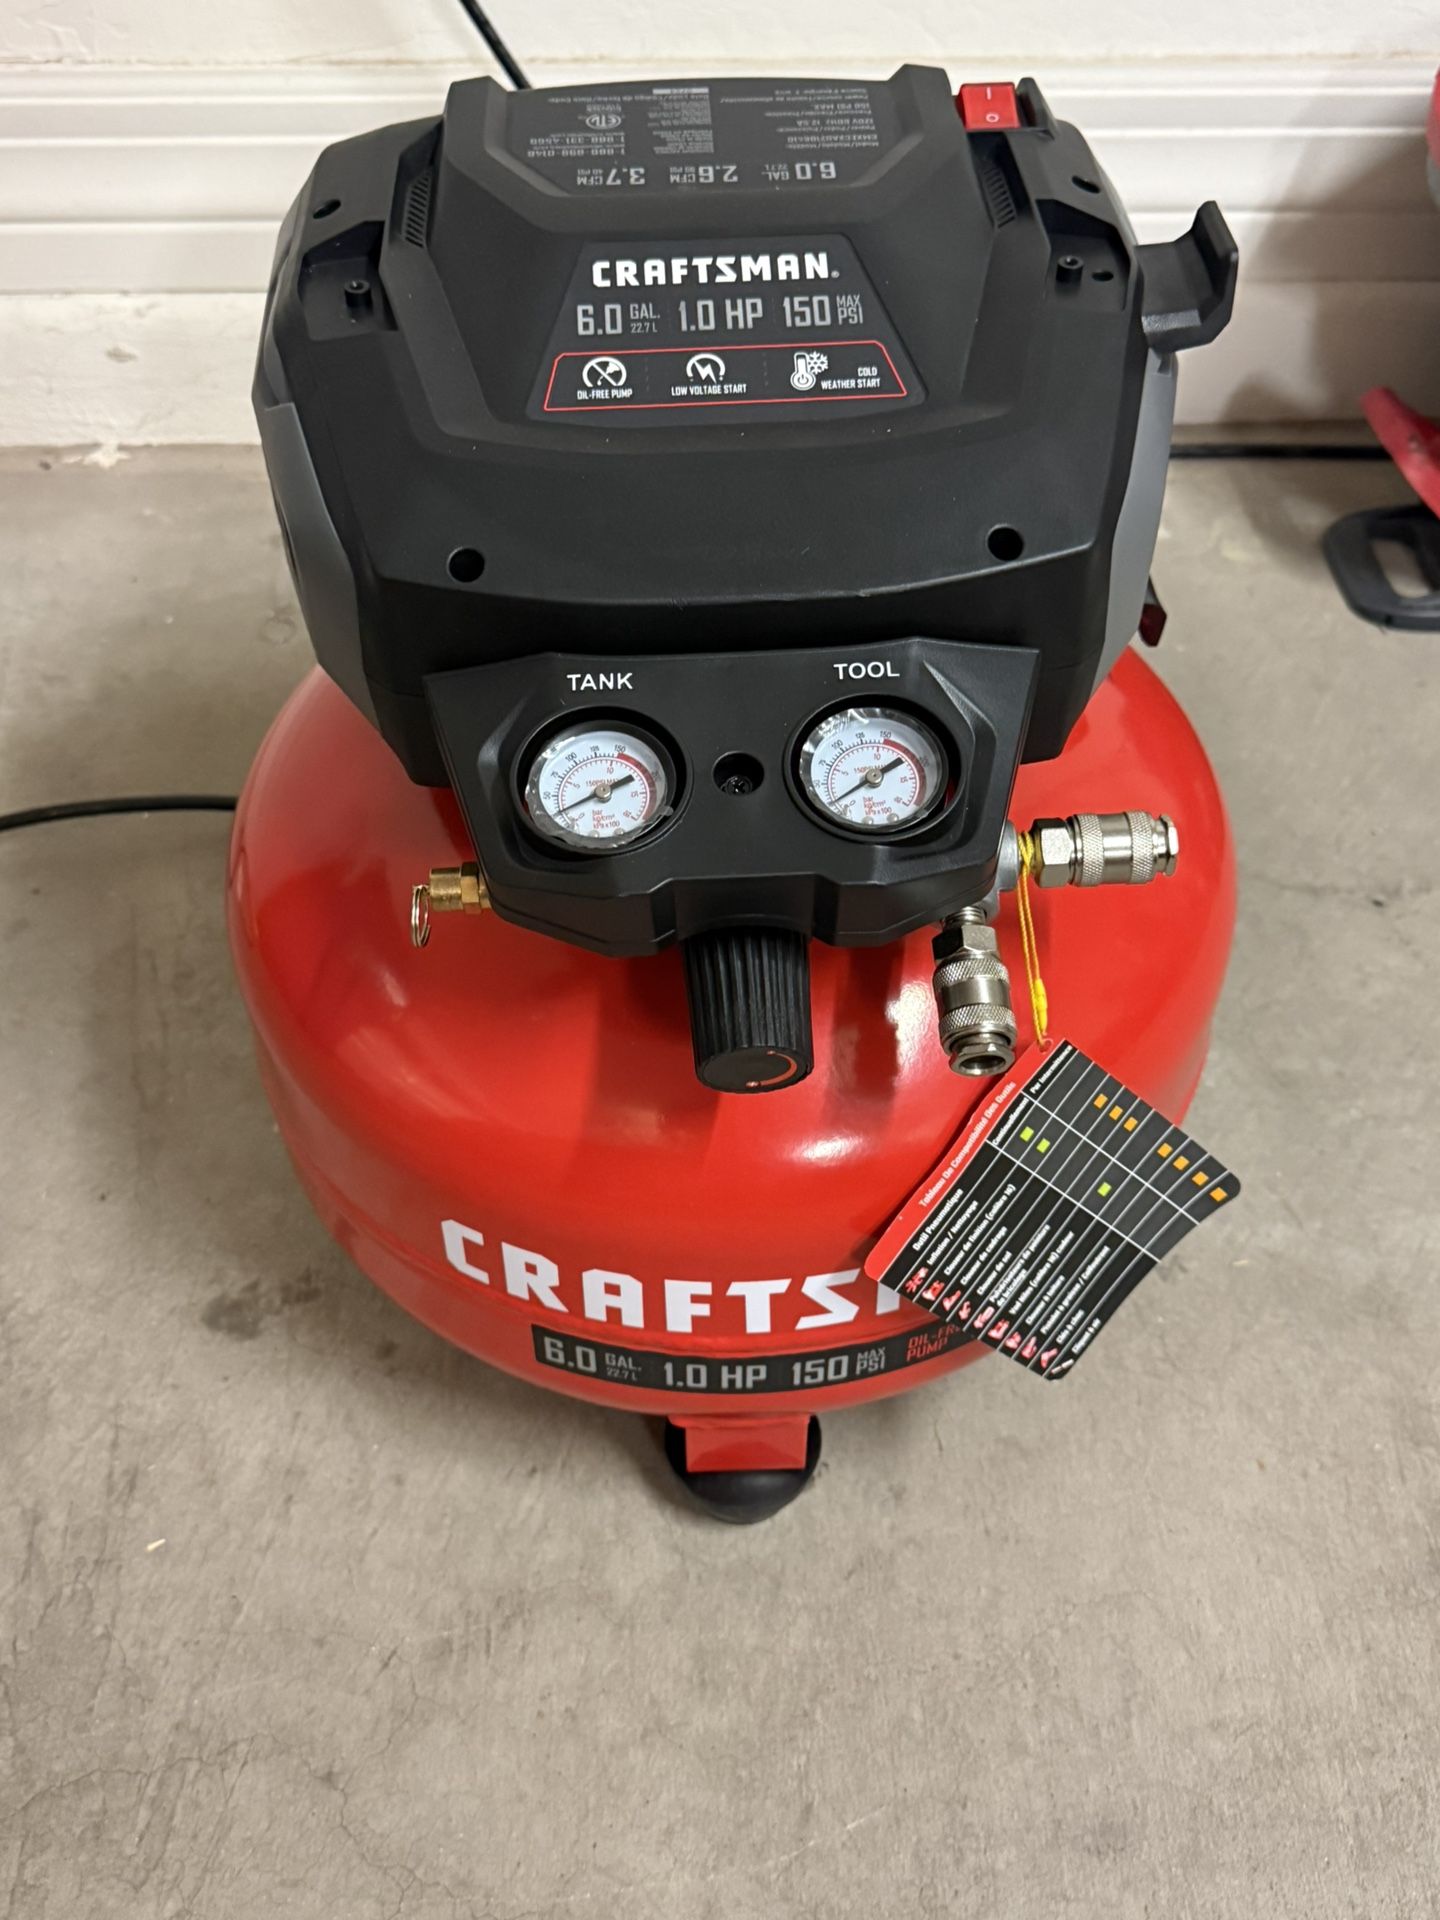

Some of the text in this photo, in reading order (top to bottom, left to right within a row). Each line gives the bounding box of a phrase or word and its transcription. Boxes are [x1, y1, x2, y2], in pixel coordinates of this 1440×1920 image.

[576, 168, 645, 185] 3.7 CFM
[670, 165, 738, 184] 2.6 CFM
[762, 162, 836, 180] 6.0 GAL.
[836, 294, 861, 307] MAX
[577, 302, 660, 336] 6.0 GAL.
[678, 298, 763, 332] 1.0 HP
[783, 295, 832, 328] 150
[838, 306, 863, 326] PSI
[630, 322, 658, 333] 22.7 L
[858, 366, 878, 377] COLD
[671, 384, 747, 396] LOW VOLTAGE START
[821, 378, 881, 390] WEATHER START
[577, 388, 633, 400] OIL-FREE PUMP
[833, 661, 900, 680] TOOL
[567, 672, 633, 691] TANK
[831, 739, 844, 749] 100
[880, 731, 892, 739] 150
[565, 752, 577, 763] 100
[614, 744, 627, 752] 150
[1030, 1082, 1040, 1093] Par
[918, 1080, 1016, 1207] Tableau De Compatibilité Des Outils
[912, 1187, 964, 1251] Outil Pneumatique
[926, 1236, 950, 1265] Inflation
[950, 1199, 979, 1234] Nettoyage
[943, 1249, 966, 1275] Cloueur
[961, 1240, 972, 1251] de
[968, 1217, 989, 1242] finition
[984, 1193, 1009, 1221] (calibre
[959, 1259, 982, 1285] Cloueur
[977, 1250, 988, 1261] de
[976, 1269, 998, 1295] Cloueur
[994, 1260, 1004, 1271] de
[543, 1335, 642, 1374] 6.0 GAL.
[857, 1347, 886, 1362] MAX
[906, 1337, 949, 1362] PUMP
[663, 1361, 767, 1390] 1.0 HP
[791, 1354, 849, 1386] 150
[856, 1356, 886, 1376] PSI
